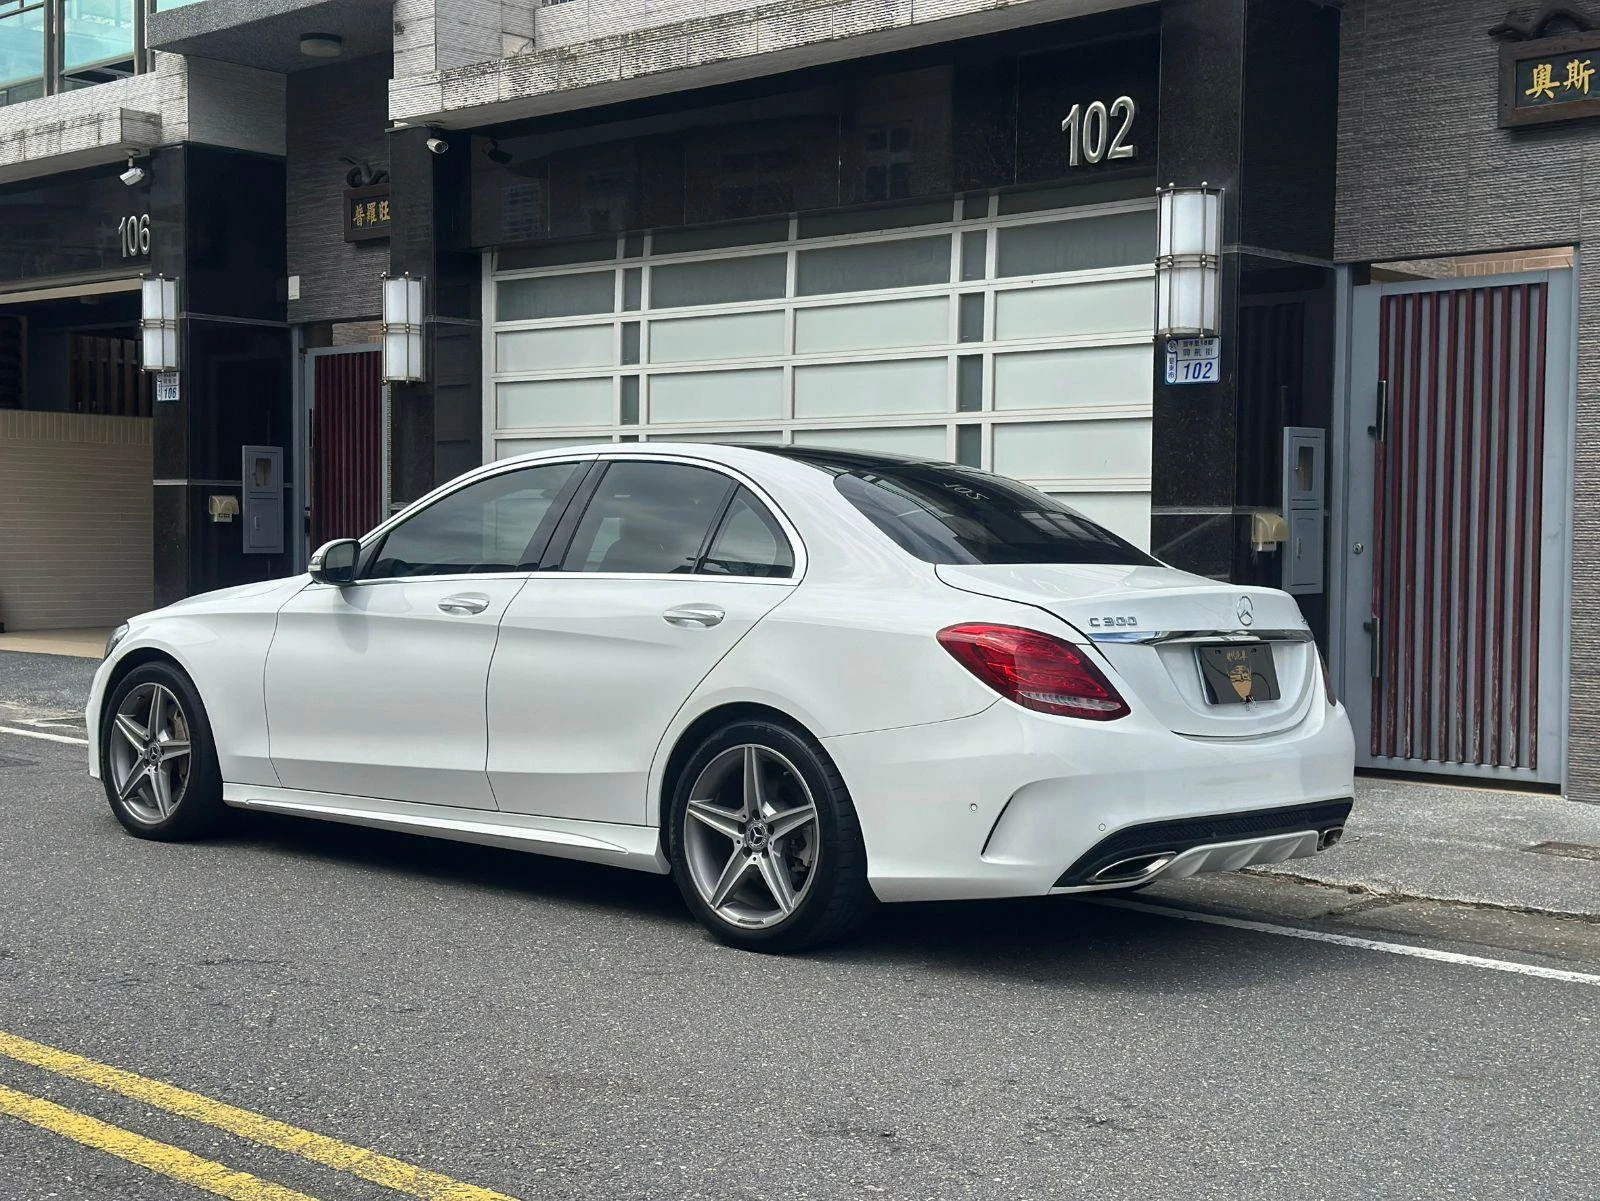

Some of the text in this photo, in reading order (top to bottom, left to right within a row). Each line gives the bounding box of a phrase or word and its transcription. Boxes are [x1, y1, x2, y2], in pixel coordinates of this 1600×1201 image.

[1525, 58, 1596, 99] 奧斯
[1061, 95, 1135, 167] 102
[352, 200, 391, 227] 普羅旺
[118, 213, 151, 258] 106
[1183, 361, 1213, 380] 102
[164, 387, 177, 399] 106
